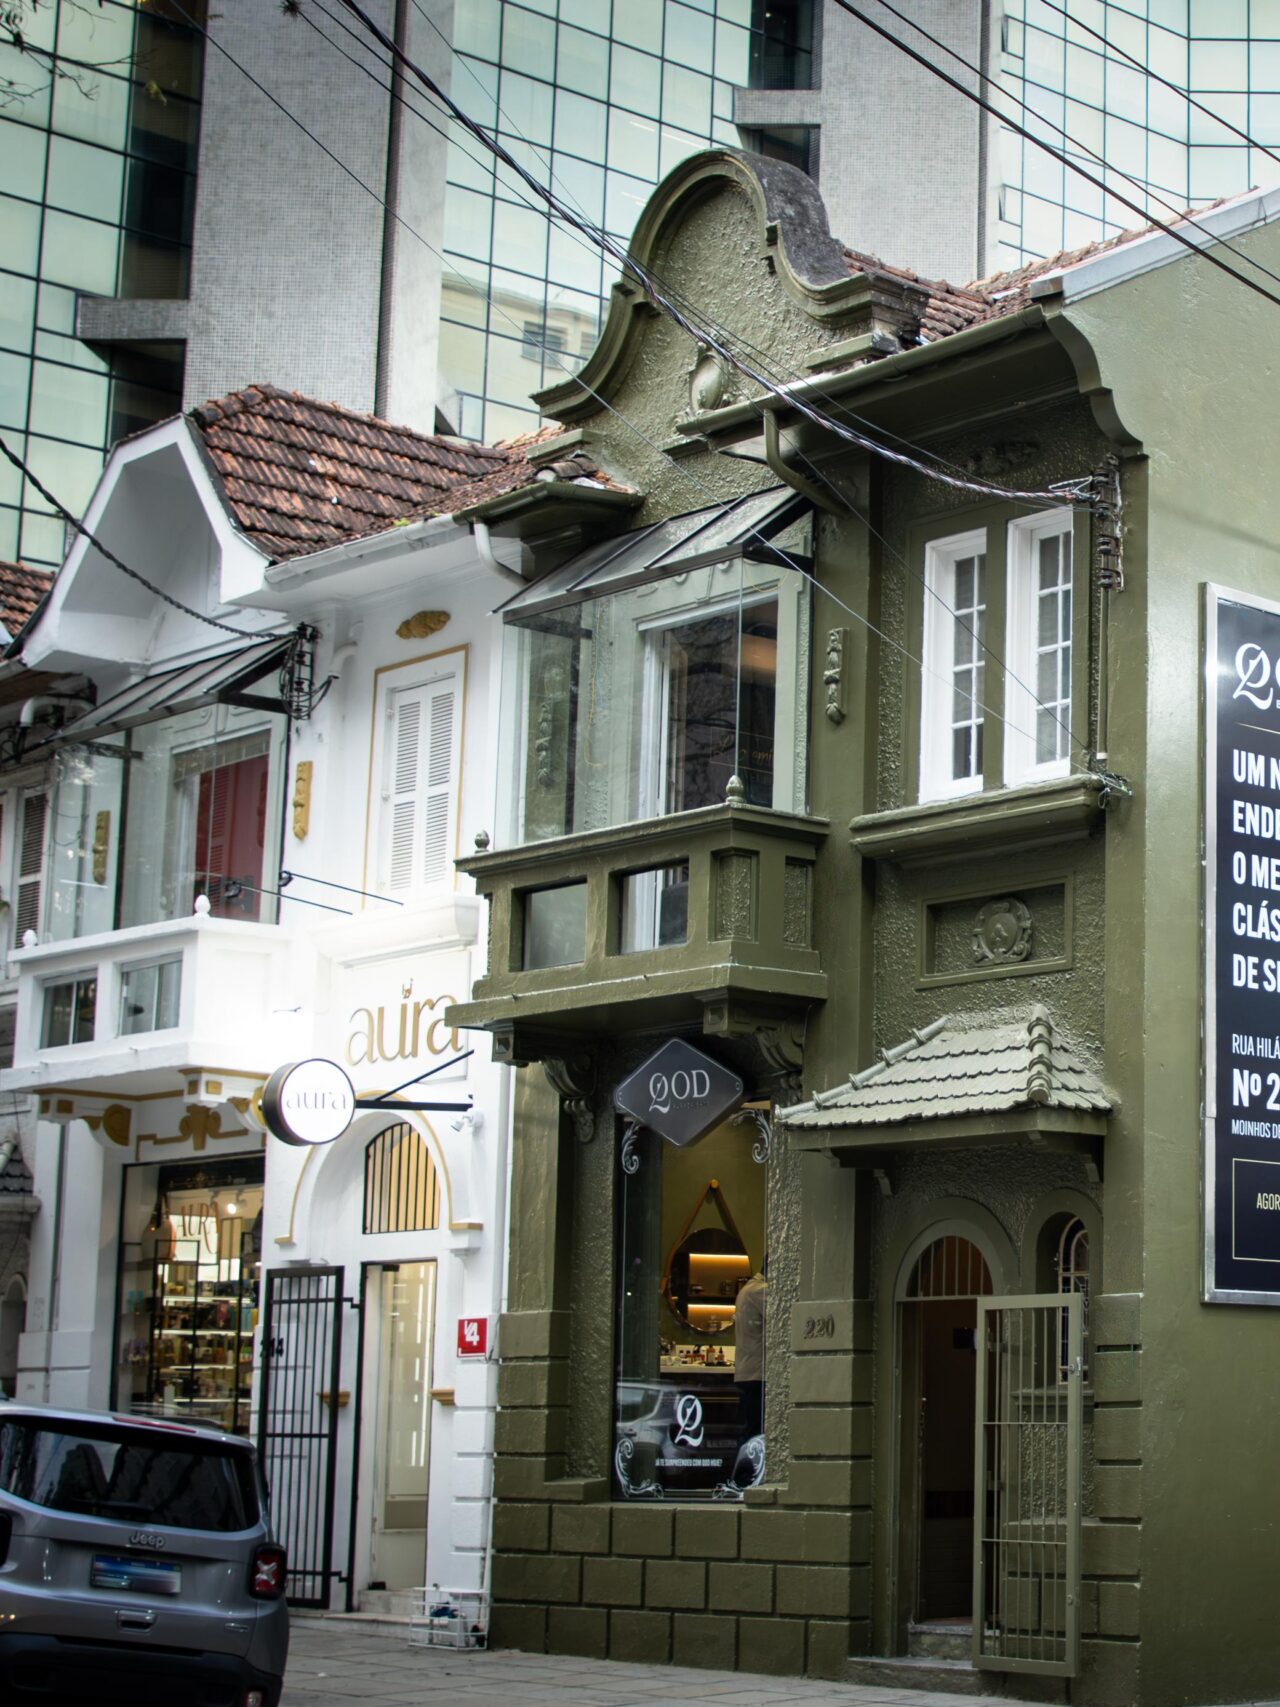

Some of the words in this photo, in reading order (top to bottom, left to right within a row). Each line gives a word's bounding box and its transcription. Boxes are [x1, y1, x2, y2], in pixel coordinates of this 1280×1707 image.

[1233, 749, 1264, 786] UM
[1233, 851, 1246, 884] O
[1233, 954, 1258, 989] DE
[346, 995, 464, 1066] aura
[1232, 1034, 1255, 1056] RUA
[286, 1091, 346, 1110] aura
[649, 1070, 710, 1113] QOD
[1232, 1119, 1271, 1138] MOINHOS
[803, 1314, 835, 1339] 220
[130, 1531, 165, 1548] Jeep
